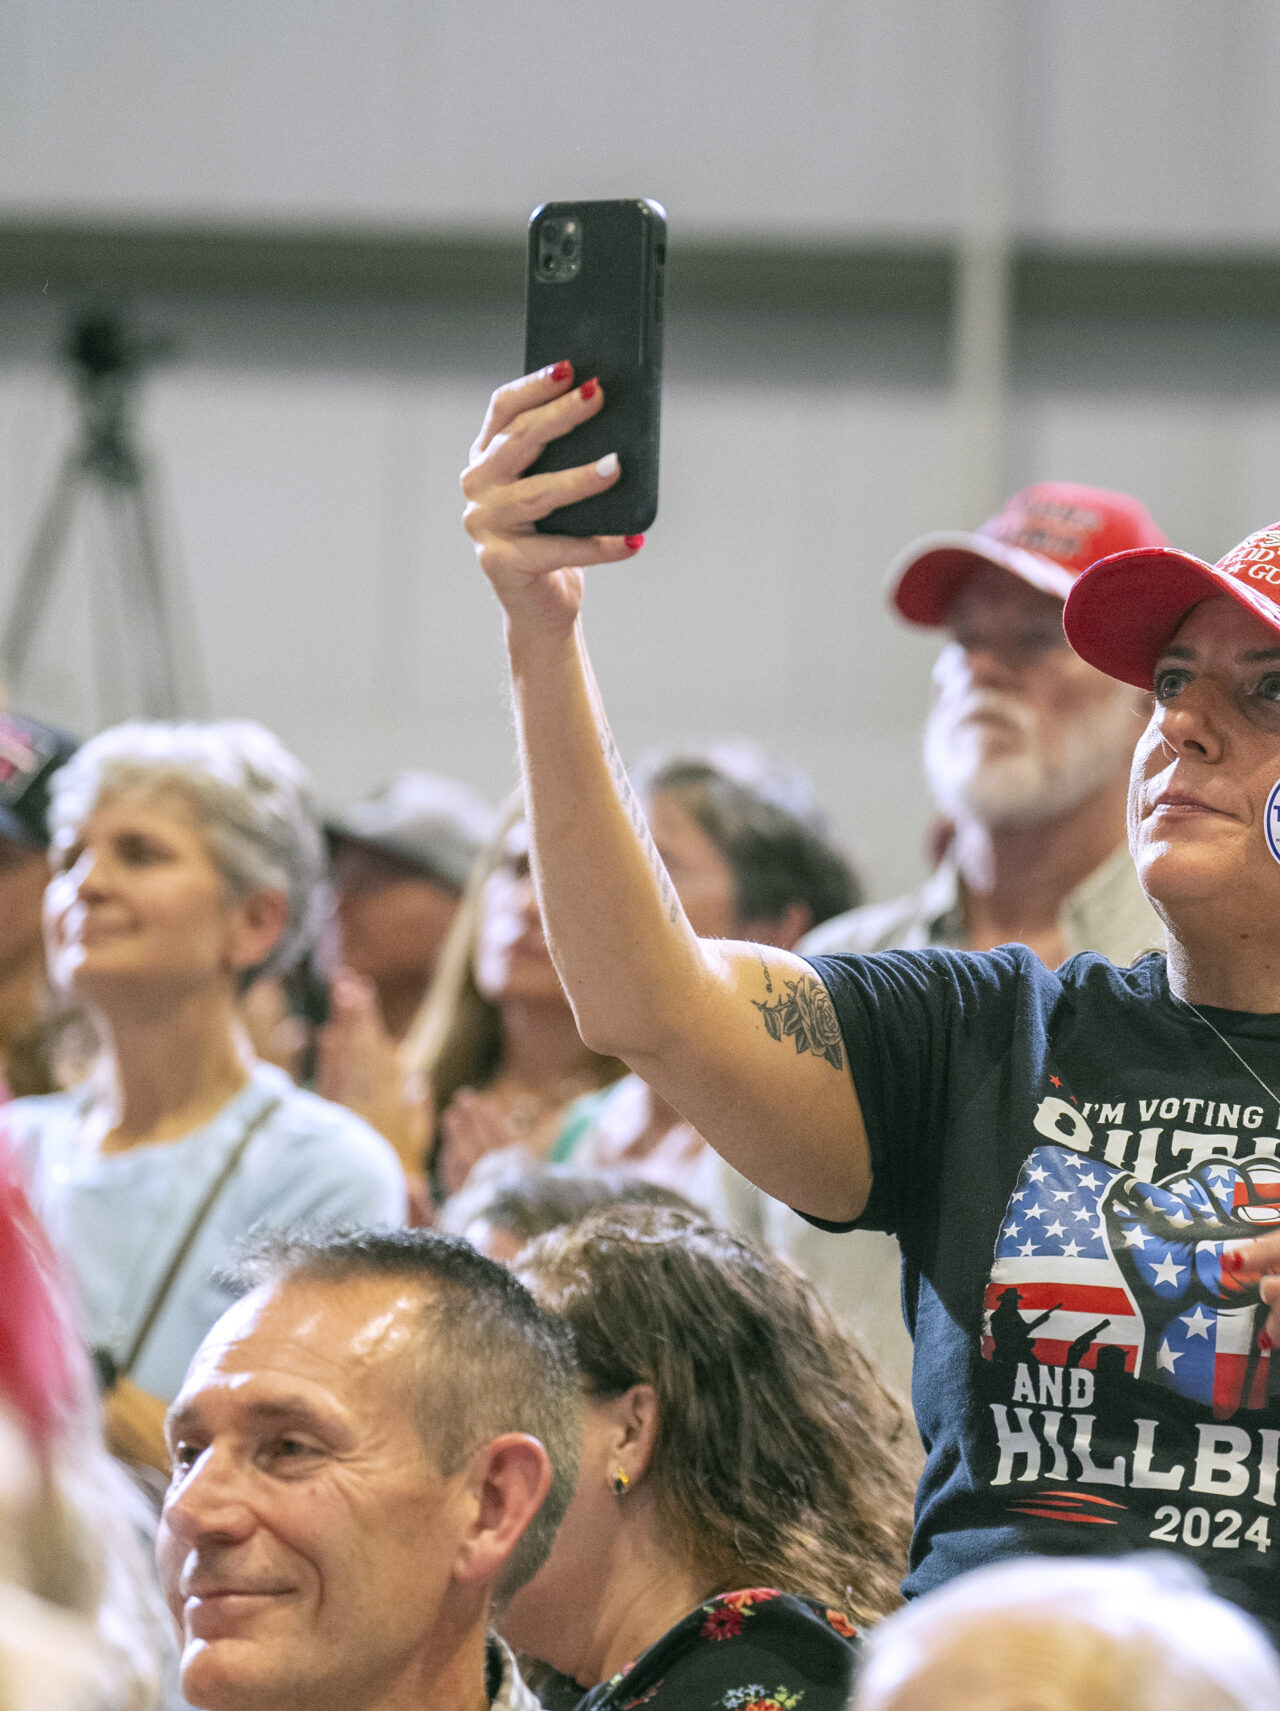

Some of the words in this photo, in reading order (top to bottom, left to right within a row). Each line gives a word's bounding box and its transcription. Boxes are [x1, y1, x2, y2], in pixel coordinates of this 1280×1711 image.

[1081, 1102, 1126, 1125] I'M
[1138, 1097, 1264, 1129] VOTING
[1012, 1362, 1095, 1408] AND
[1149, 1505, 1271, 1553] 2024
